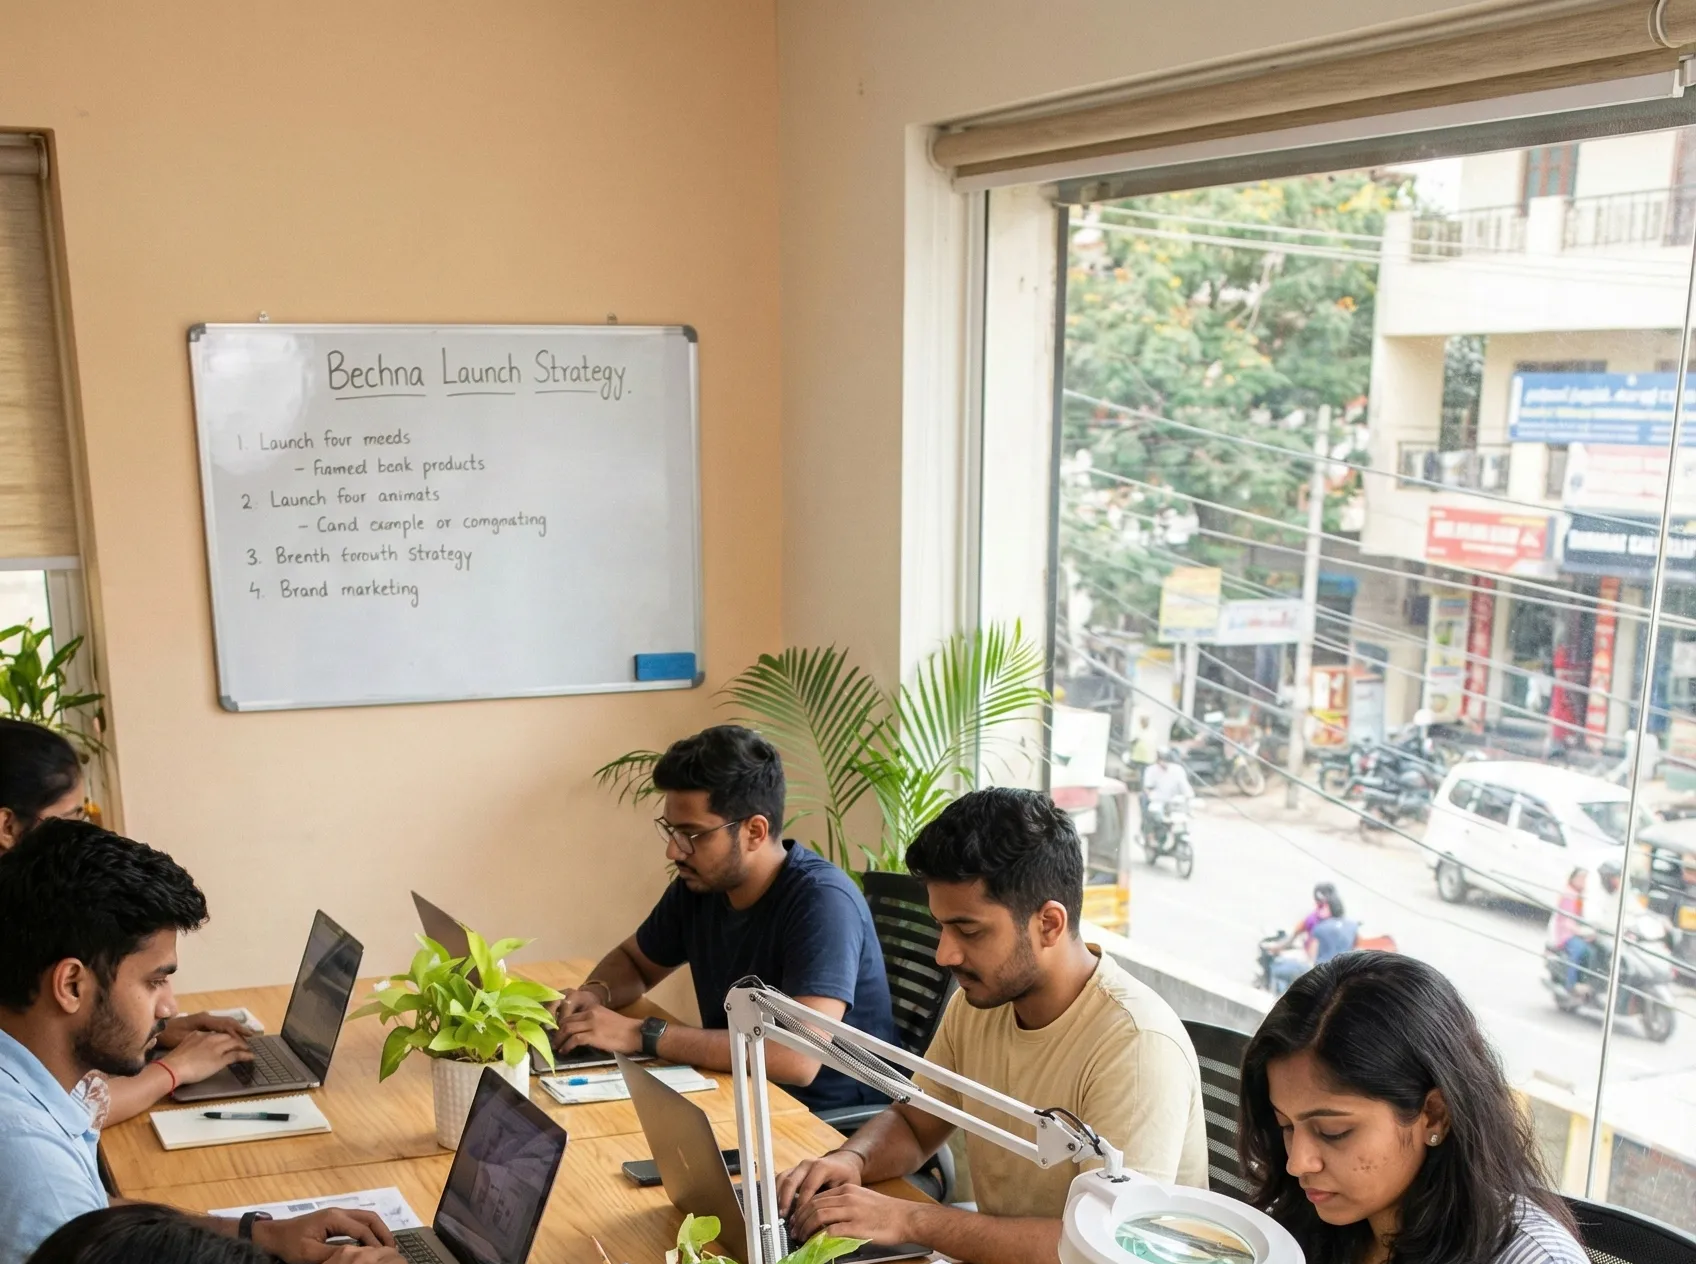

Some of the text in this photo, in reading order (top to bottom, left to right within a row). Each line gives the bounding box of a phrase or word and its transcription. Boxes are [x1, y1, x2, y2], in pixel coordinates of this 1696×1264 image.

[327, 347, 632, 401] Bechna Launch Strategy.
[260, 432, 314, 451] Launch
[324, 429, 351, 447] four
[423, 453, 485, 480] products
[270, 490, 326, 508] Launch
[337, 487, 366, 504] four
[316, 517, 359, 533] Cand
[436, 518, 451, 529] or
[275, 546, 330, 565] Brenth
[280, 580, 328, 599] Brand
[341, 579, 419, 609] marketing
